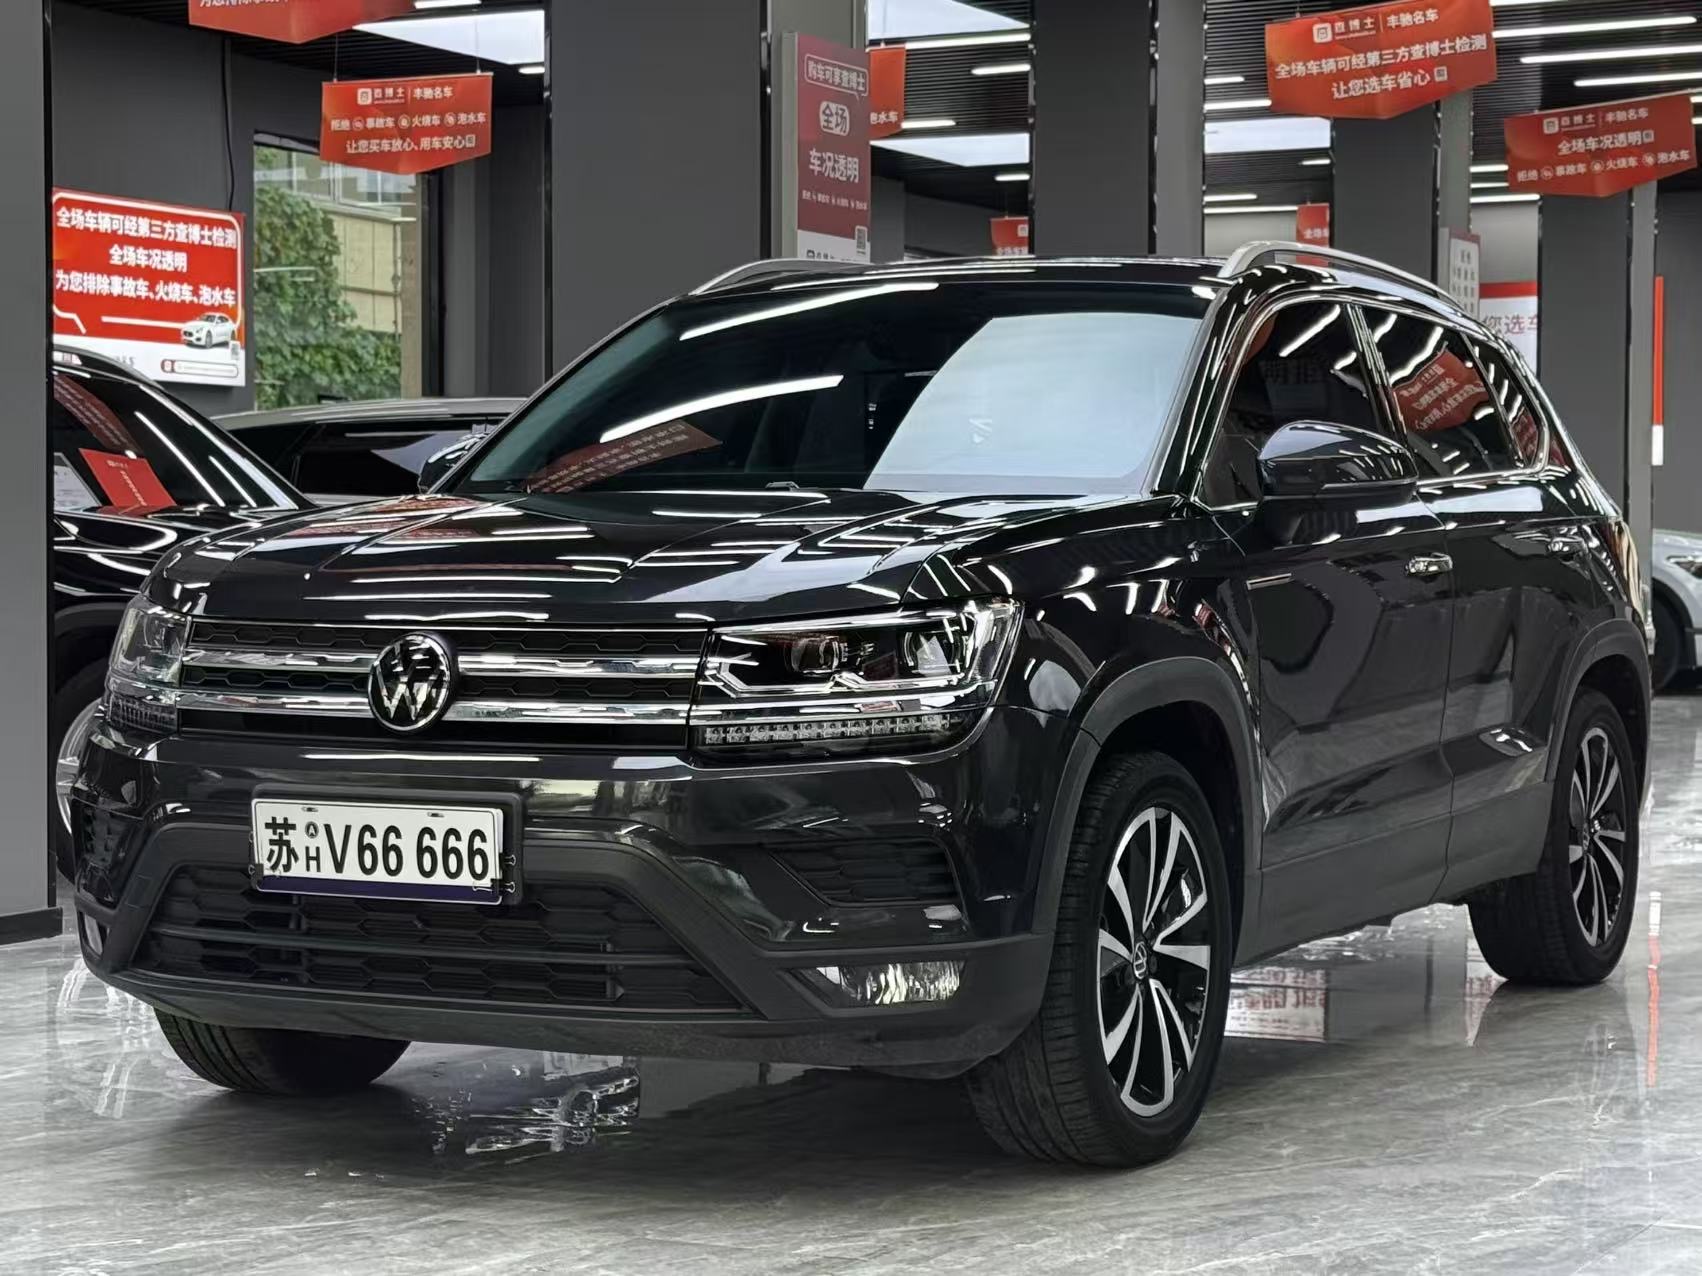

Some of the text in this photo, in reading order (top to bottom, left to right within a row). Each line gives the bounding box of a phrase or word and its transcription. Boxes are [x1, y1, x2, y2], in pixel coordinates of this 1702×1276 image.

[1275, 34, 1487, 80] 全场车辆可经第三方查博士检测
[1331, 69, 1431, 99] 让您选车省心
[822, 103, 848, 134] 全场
[1558, 131, 1642, 156] 全场车况透明
[809, 147, 860, 183] 车况透明
[56, 206, 237, 250] 全场车辆可经第三方查博士检测
[109, 243, 188, 273] 全场车况透明
[55, 269, 237, 308] 为您排除事故车、火烧车、泡水车
[265, 816, 299, 873] 苏
